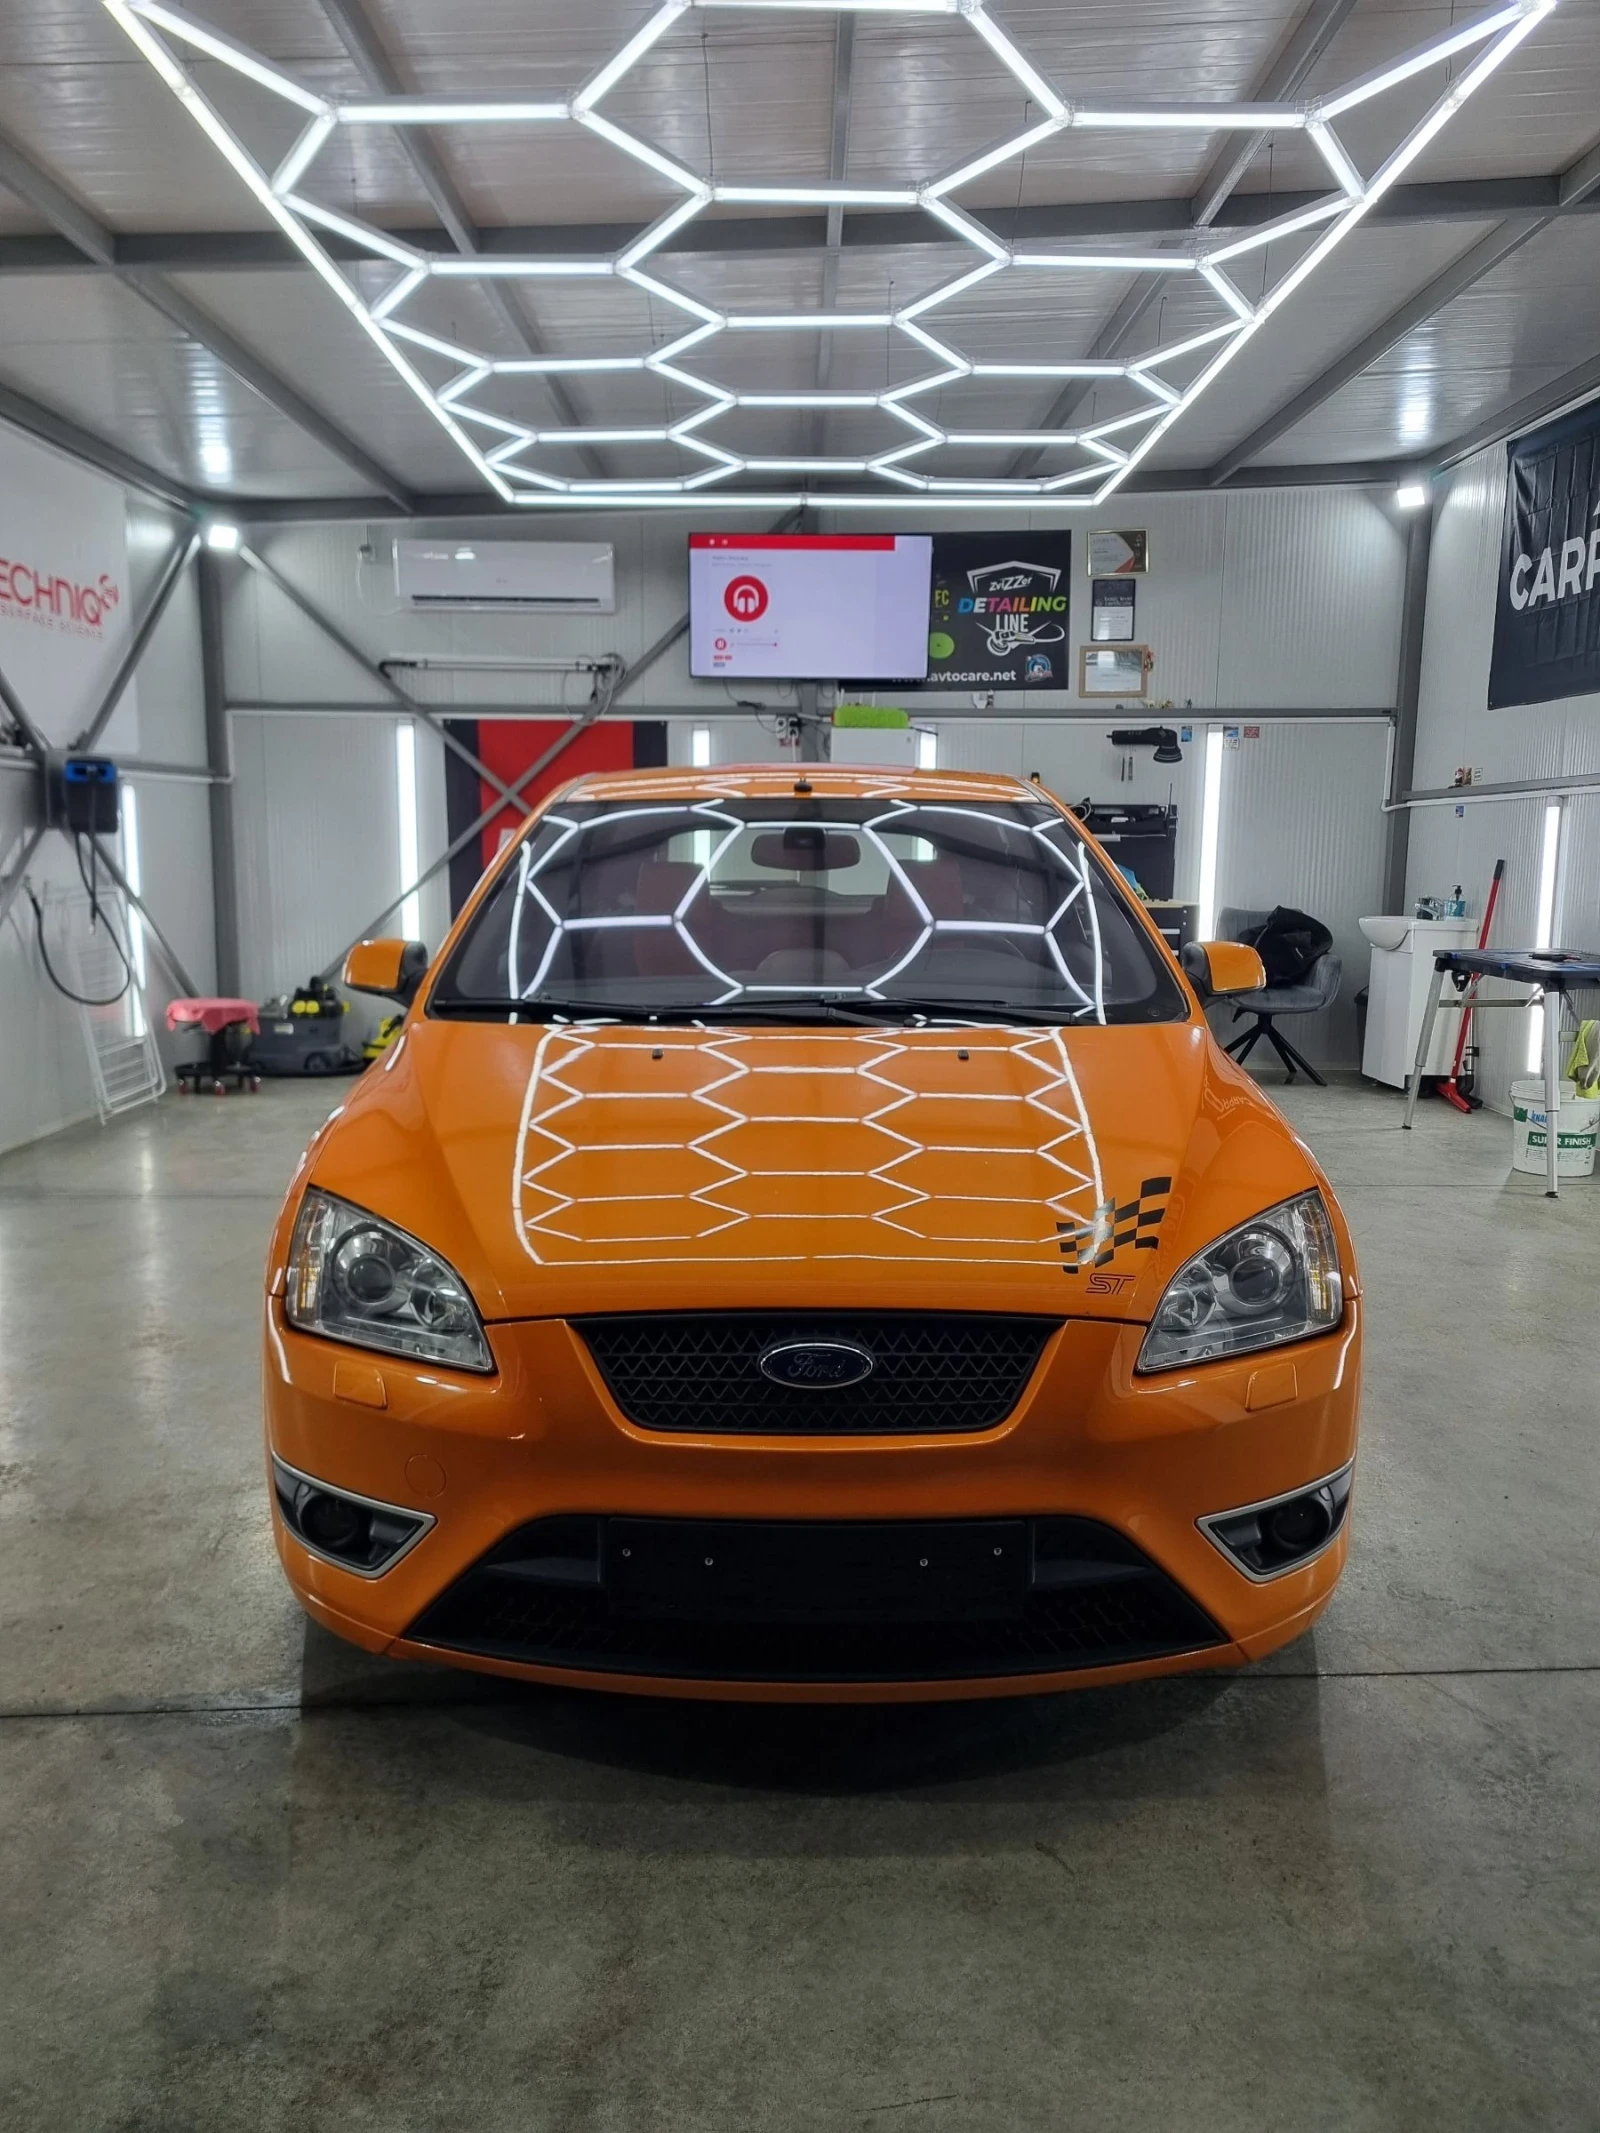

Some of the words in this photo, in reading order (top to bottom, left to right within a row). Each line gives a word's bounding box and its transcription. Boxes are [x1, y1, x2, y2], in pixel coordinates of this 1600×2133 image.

[957, 596, 1067, 614] DETAILING
[995, 613, 1030, 633] LINE
[1531, 1134, 1562, 1146] SUR
[1564, 1136, 1592, 1147] FINISH
[1085, 1272, 1136, 1295] ST
[787, 1352, 847, 1379] Ford
